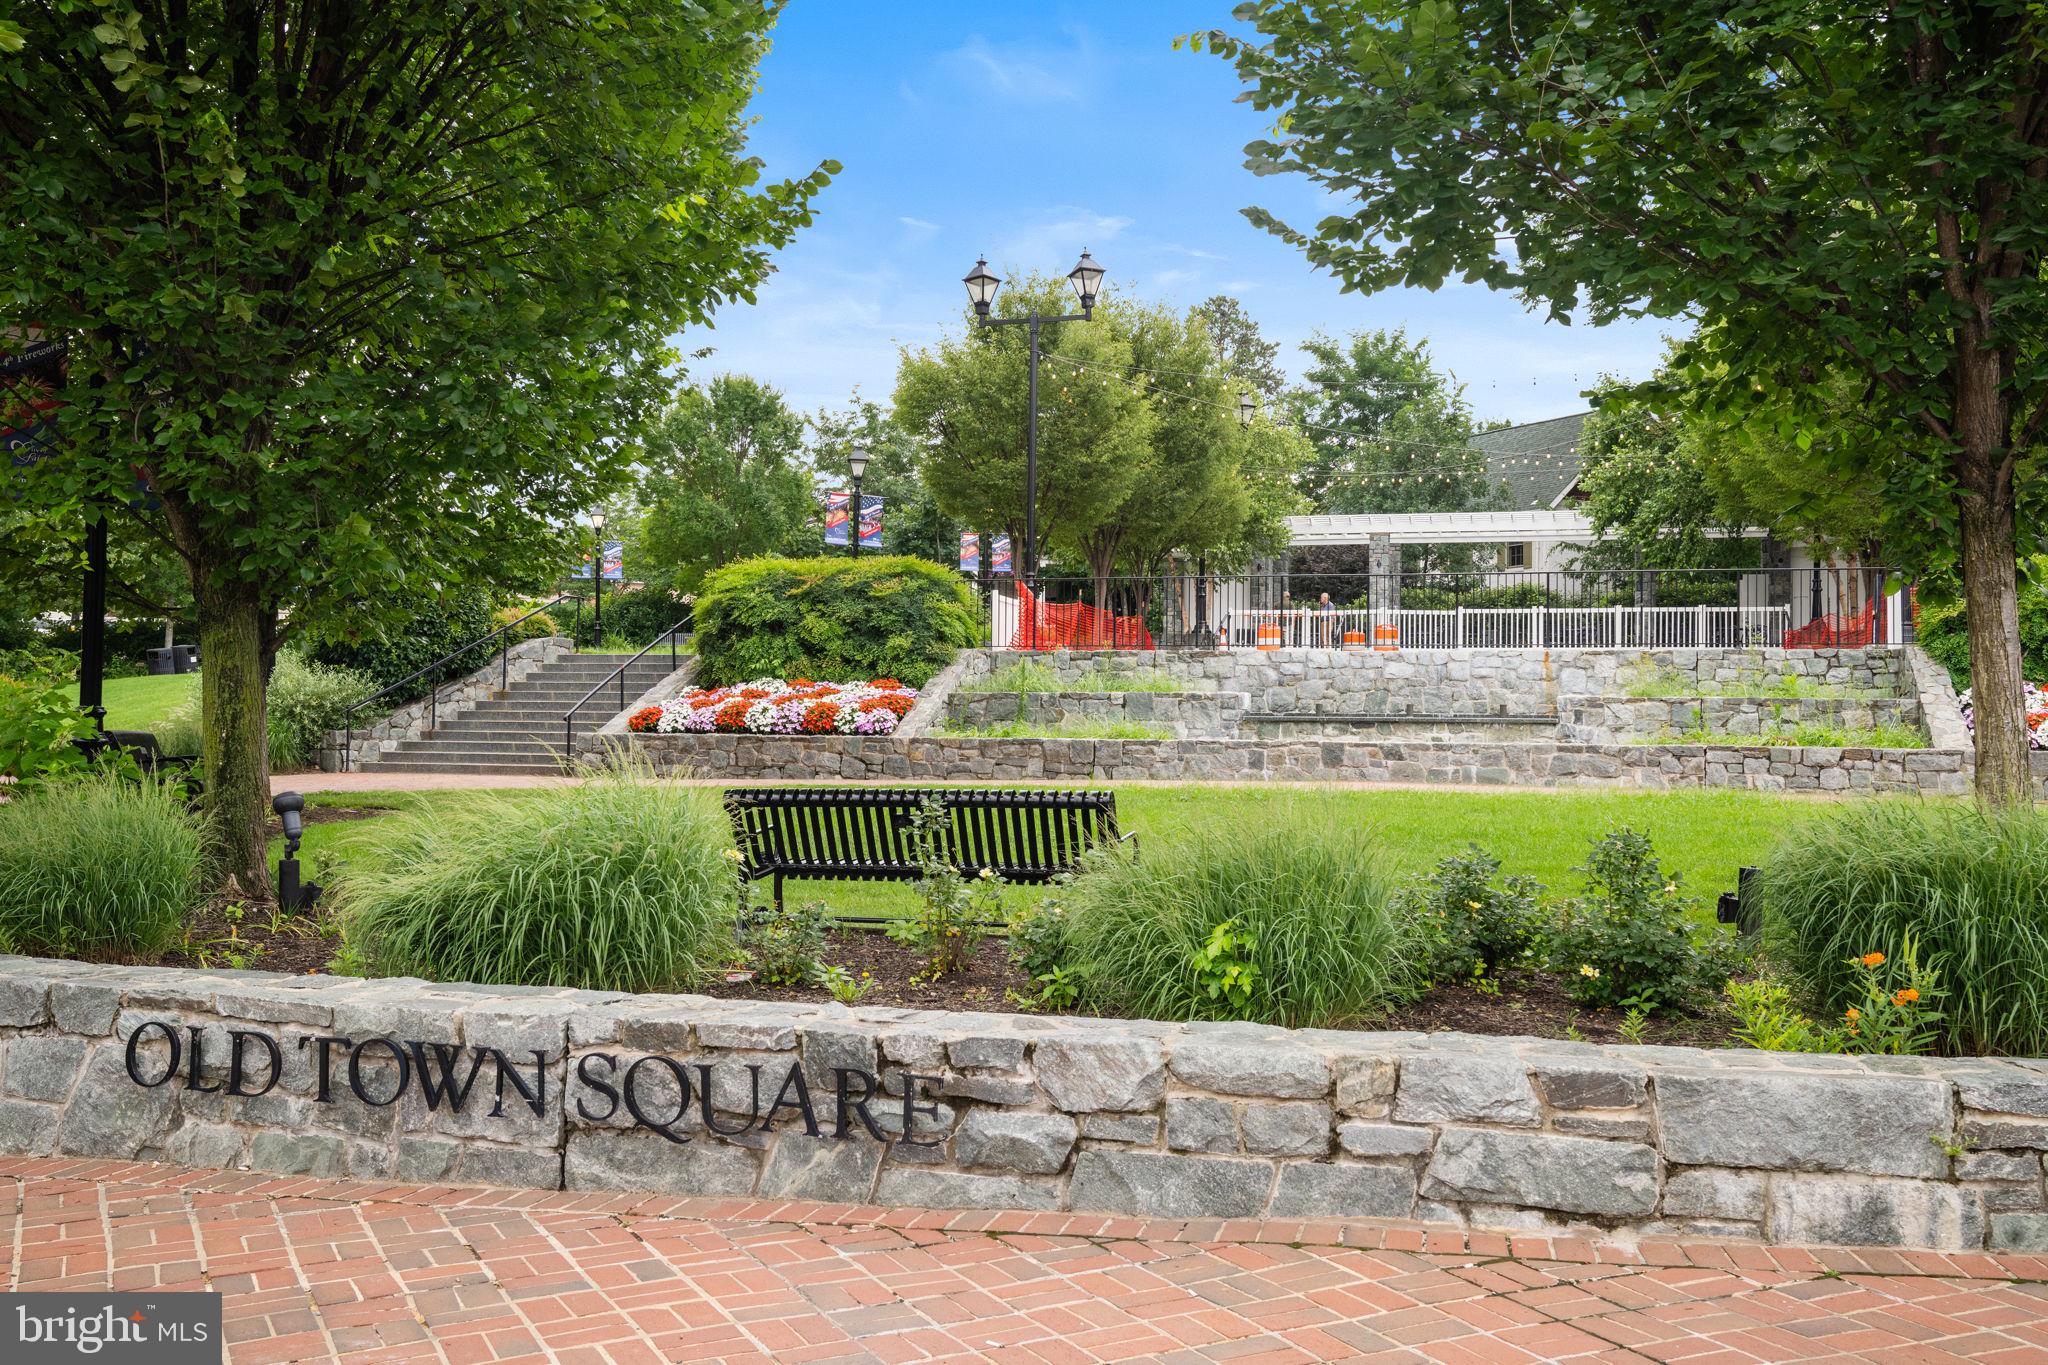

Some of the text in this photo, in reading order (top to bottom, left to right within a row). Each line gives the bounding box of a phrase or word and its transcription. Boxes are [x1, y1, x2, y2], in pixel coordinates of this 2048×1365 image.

[17, 342, 65, 363] Fireworks
[125, 1021, 946, 1147] OLD TOWN SQUARE
